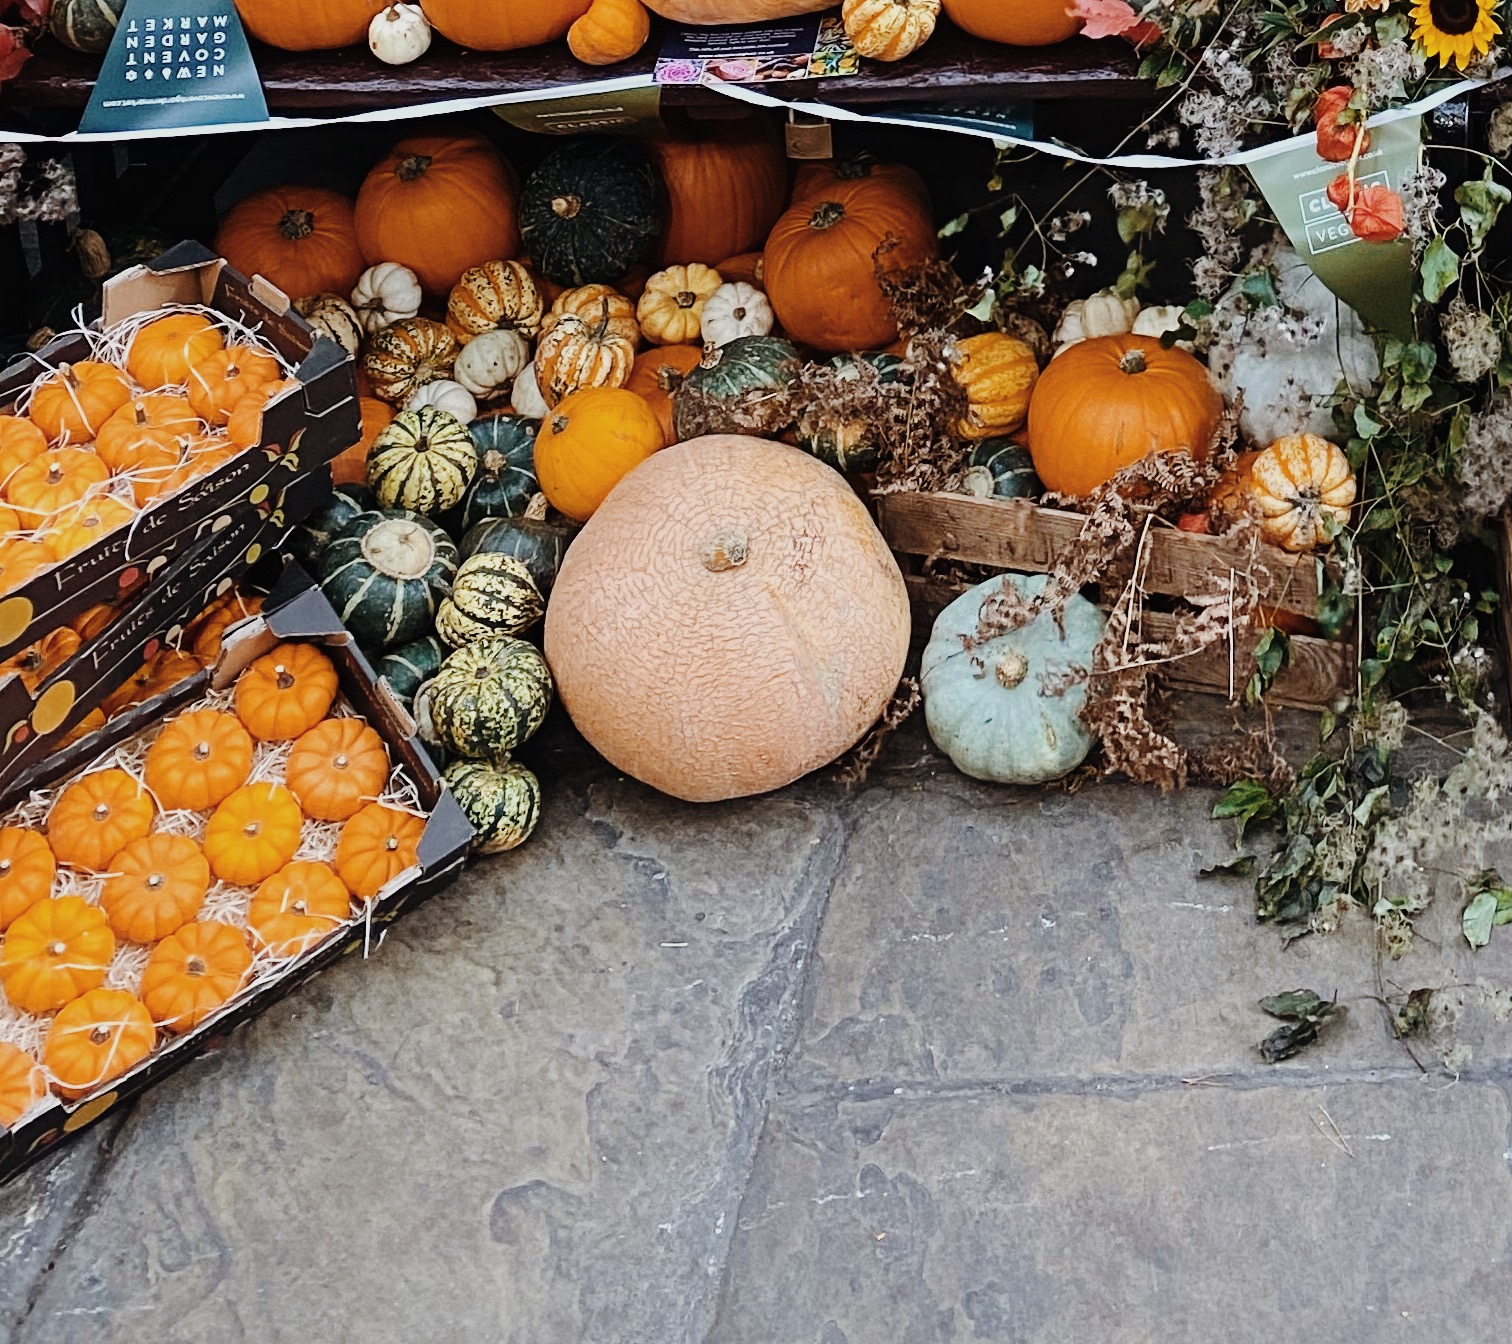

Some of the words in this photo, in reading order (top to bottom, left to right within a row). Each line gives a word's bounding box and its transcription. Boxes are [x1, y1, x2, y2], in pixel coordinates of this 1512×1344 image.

[127, 15, 228, 33] MARKET
[126, 31, 226, 49] GARDEN
[125, 48, 226, 66] COVENT
[176, 64, 225, 80] NEW
[1315, 223, 1349, 244] VEG
